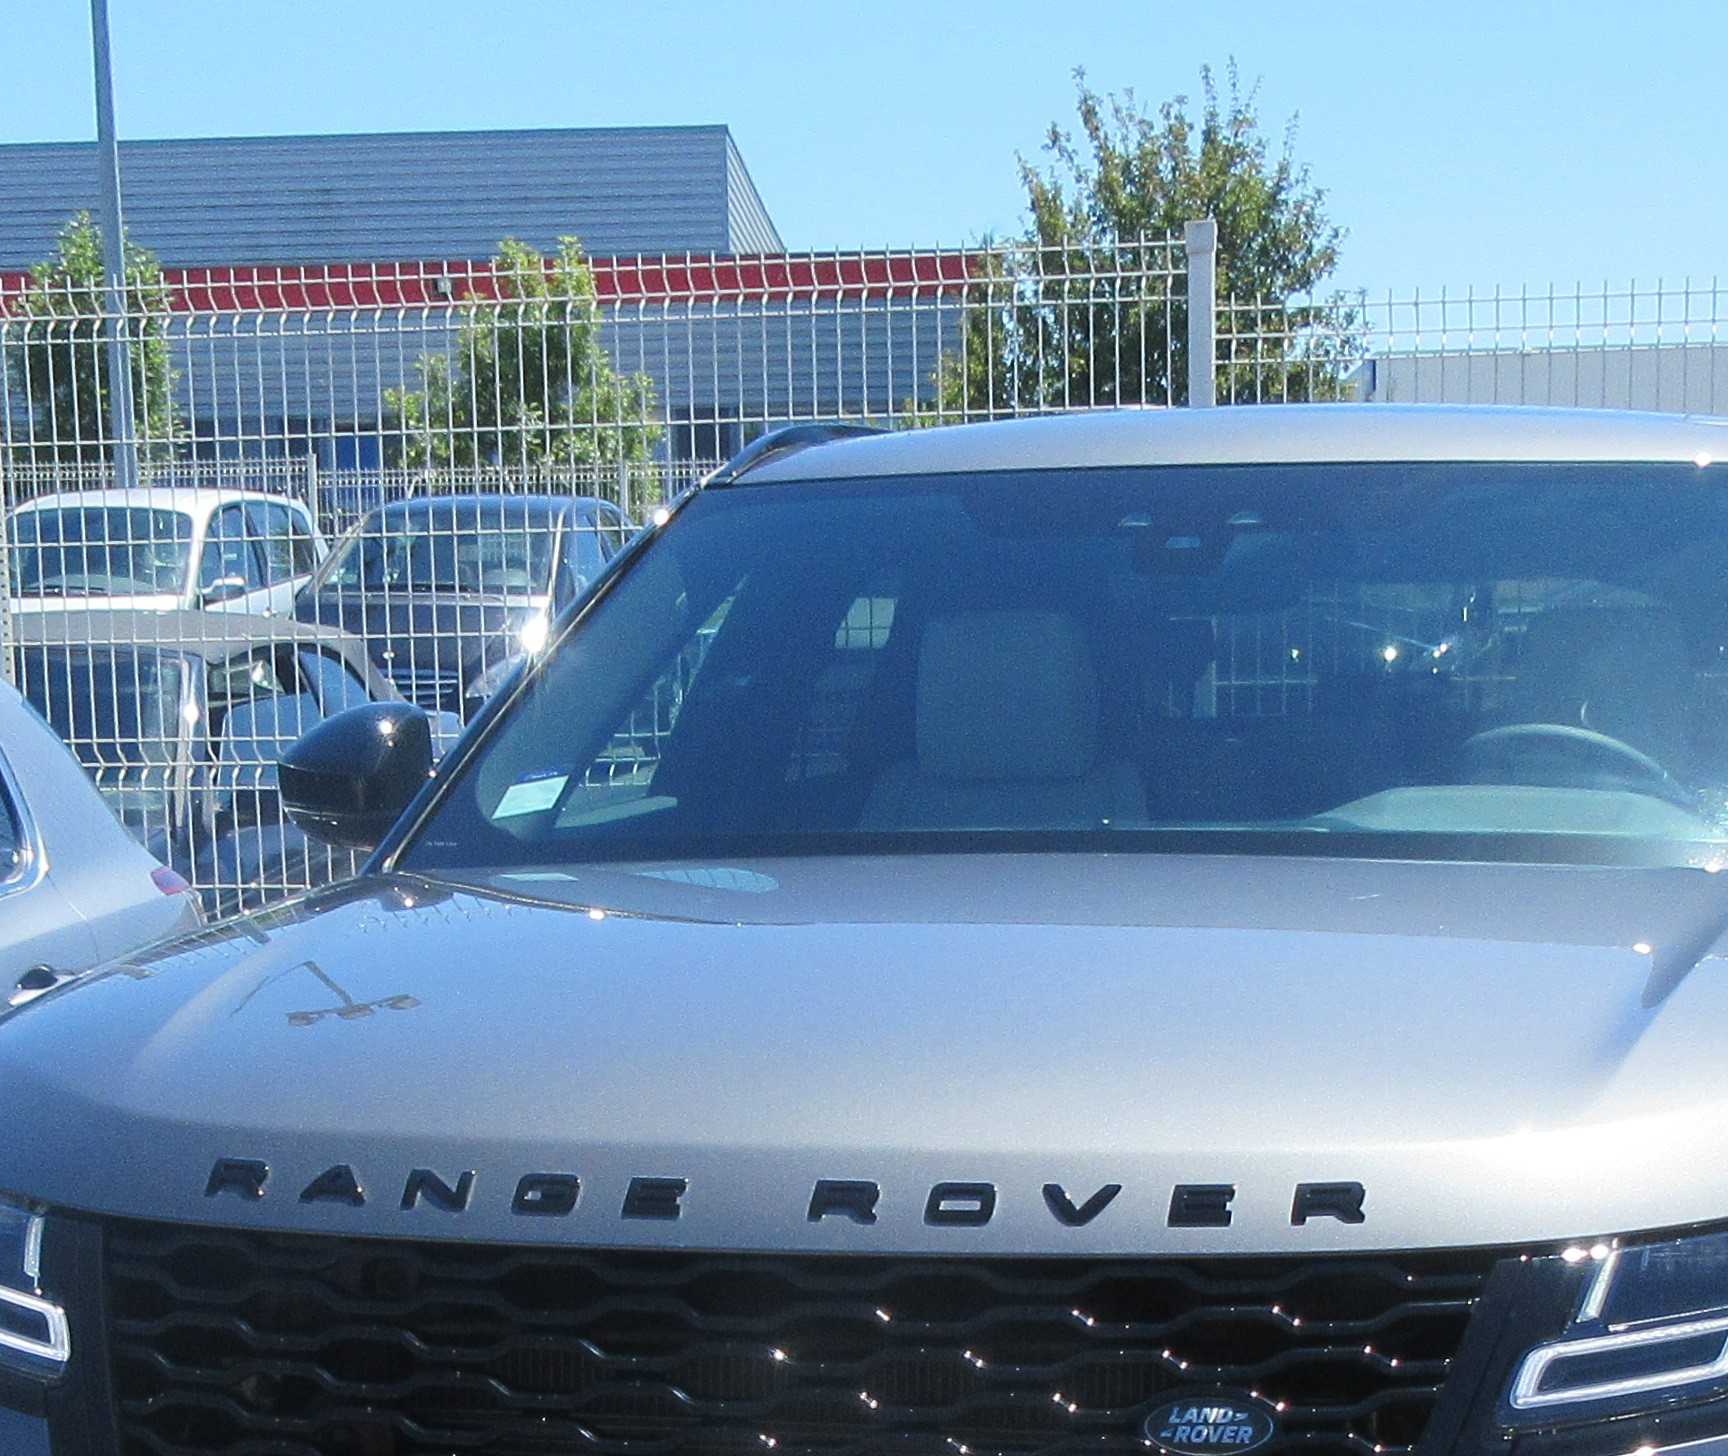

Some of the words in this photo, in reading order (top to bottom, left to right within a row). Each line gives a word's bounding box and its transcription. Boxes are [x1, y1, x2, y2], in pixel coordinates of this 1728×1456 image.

[204, 1158, 690, 1222] RANGE
[807, 1178, 1370, 1230] ROVER
[1169, 1406, 1233, 1424] LAND
[1173, 1425, 1253, 1444] ROVER
